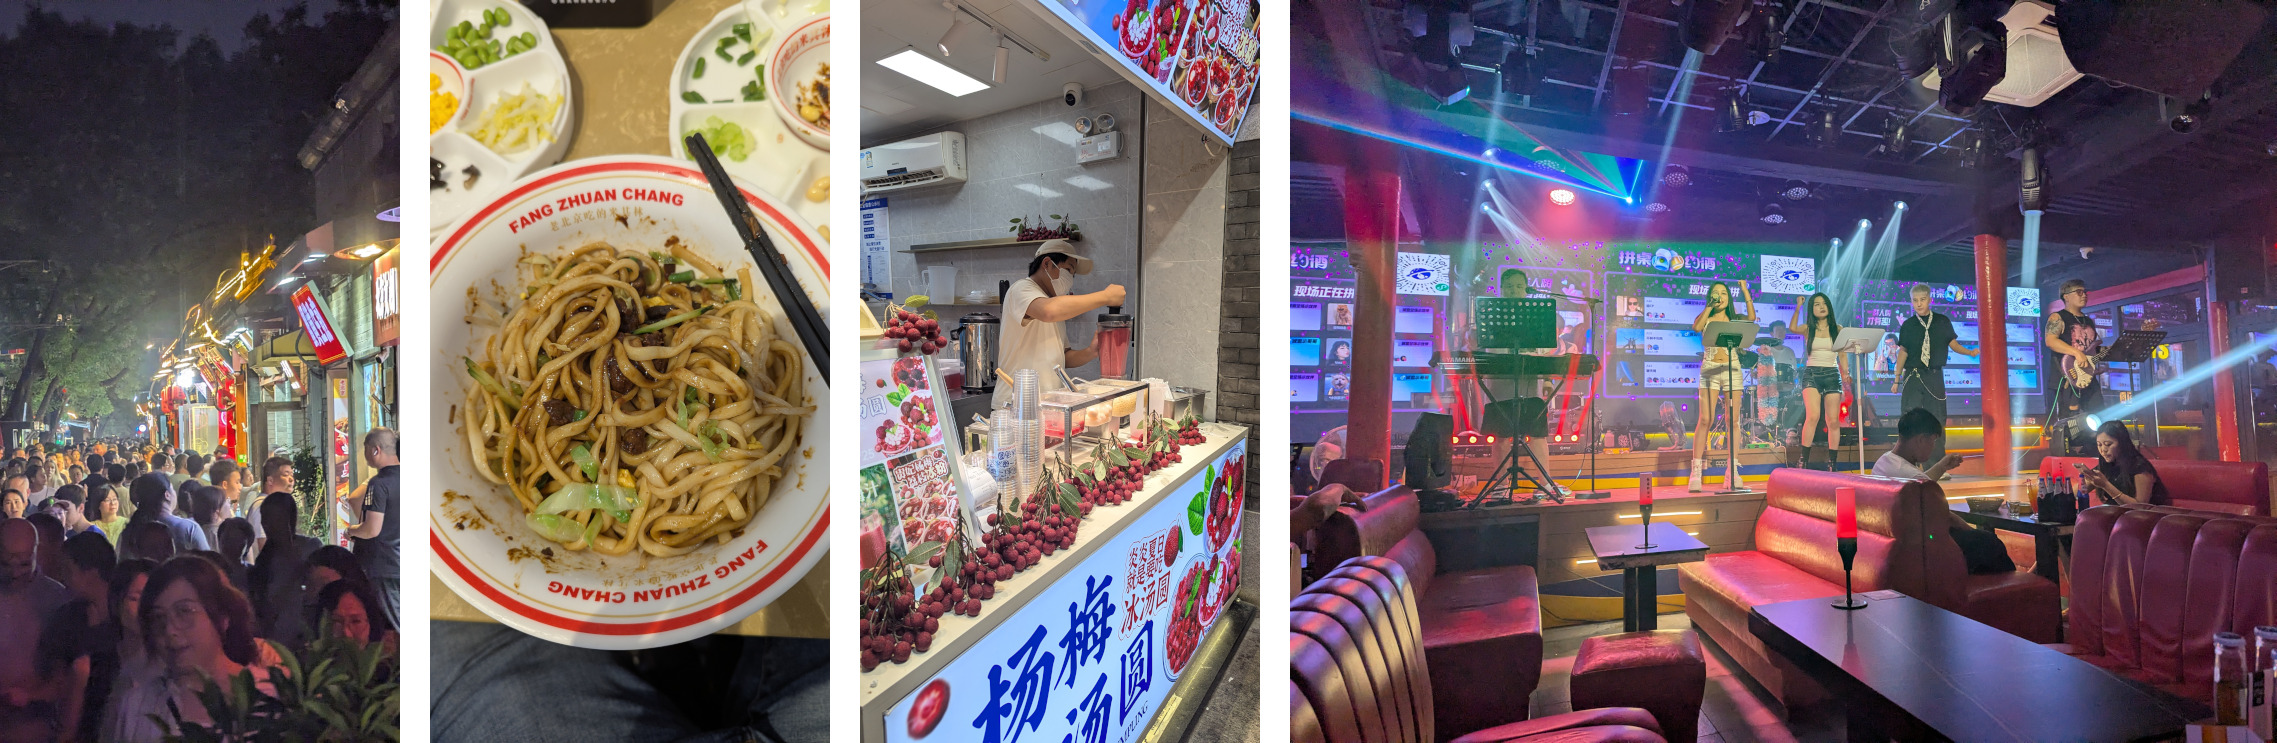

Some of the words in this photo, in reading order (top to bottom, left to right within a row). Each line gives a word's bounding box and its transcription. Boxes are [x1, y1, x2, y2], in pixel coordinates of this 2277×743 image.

[508, 204, 554, 234] FANG
[556, 188, 617, 212] ZHUAN
[622, 188, 684, 207] CHANG
[1290, 252, 1329, 271] 约酒
[1618, 250, 1652, 267] 拼桌
[1684, 255, 1717, 271] 约酒
[714, 539, 769, 580] FANG
[1128, 534, 1165, 572] 炎炎夏日
[547, 580, 627, 604] CHANG
[633, 574, 711, 603] ZHUAN
[1121, 571, 1170, 634] 冰汤圆
[972, 574, 1116, 743] 杨梅
